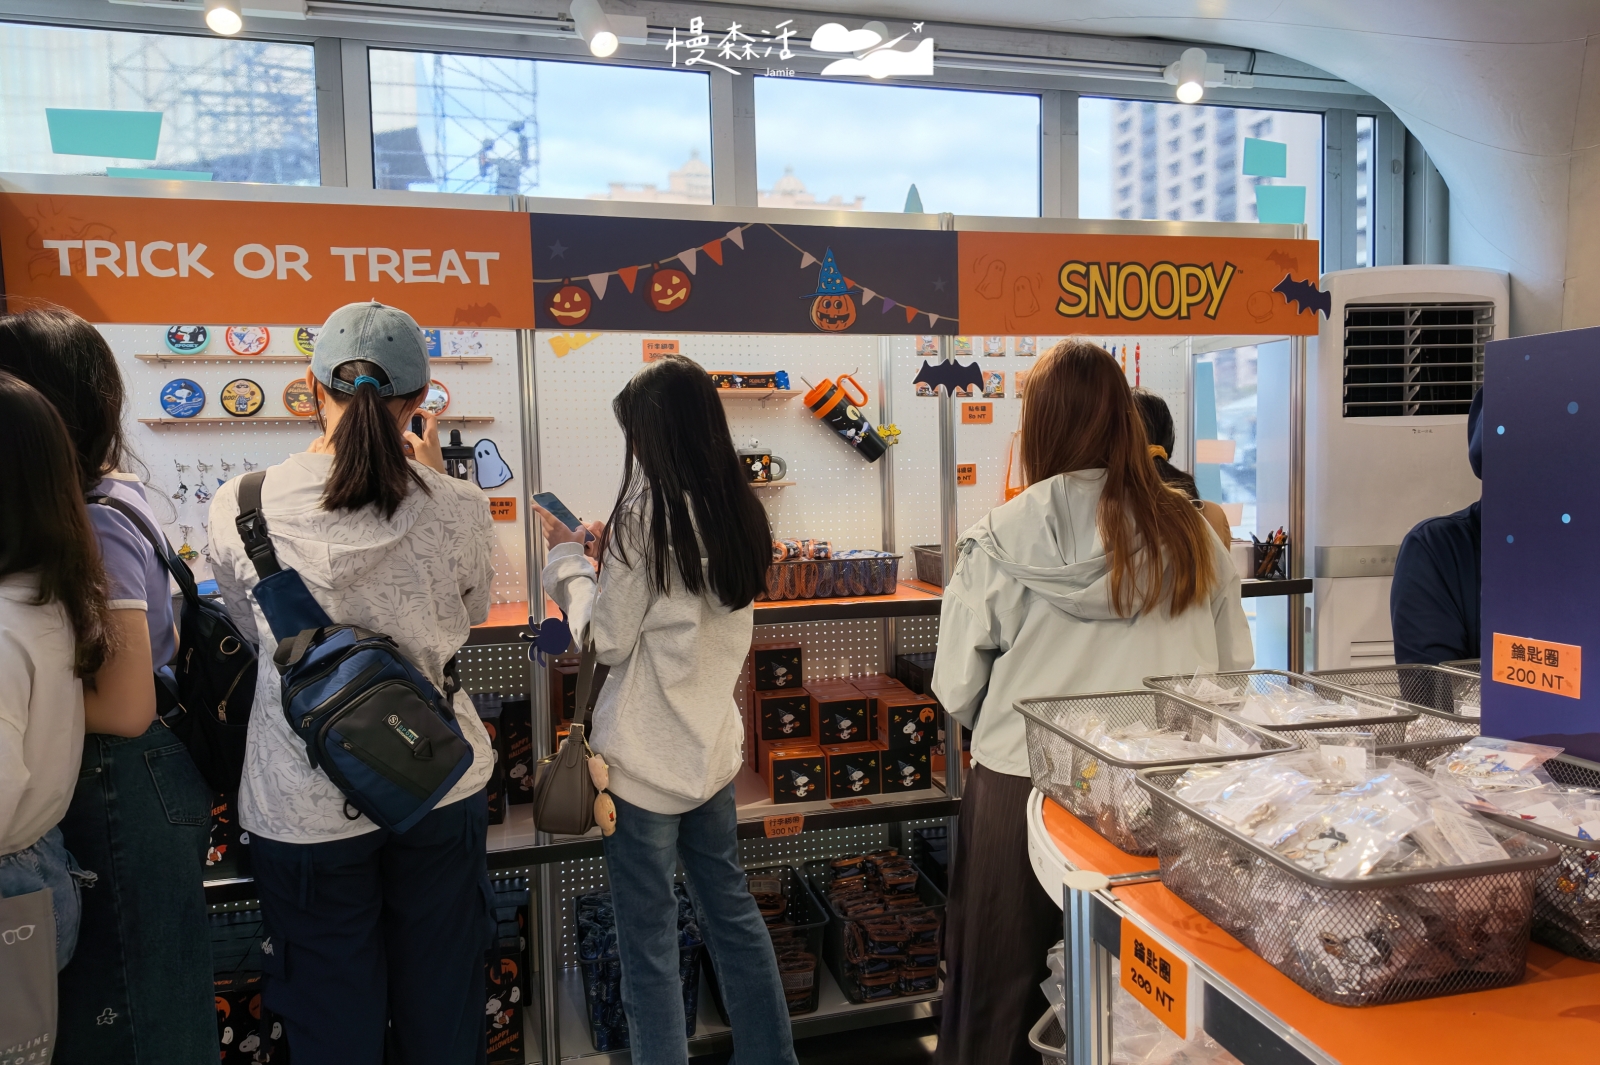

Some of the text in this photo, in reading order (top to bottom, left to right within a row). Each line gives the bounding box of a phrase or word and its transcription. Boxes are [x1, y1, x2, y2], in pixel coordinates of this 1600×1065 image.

[42, 239, 500, 286] TRICK OR TREAT
[1055, 260, 1237, 321] SNOOPY
[1511, 642, 1559, 668] 鑰匙圈
[1506, 666, 1564, 690] 200 NT
[398, 724, 417, 742] SPORT
[771, 826, 799, 836] 300 NT
[1134, 938, 1171, 984] 鑰匙圈
[1130, 967, 1174, 1013] 200 NT
[489, 1029, 509, 1045] HAPPY
